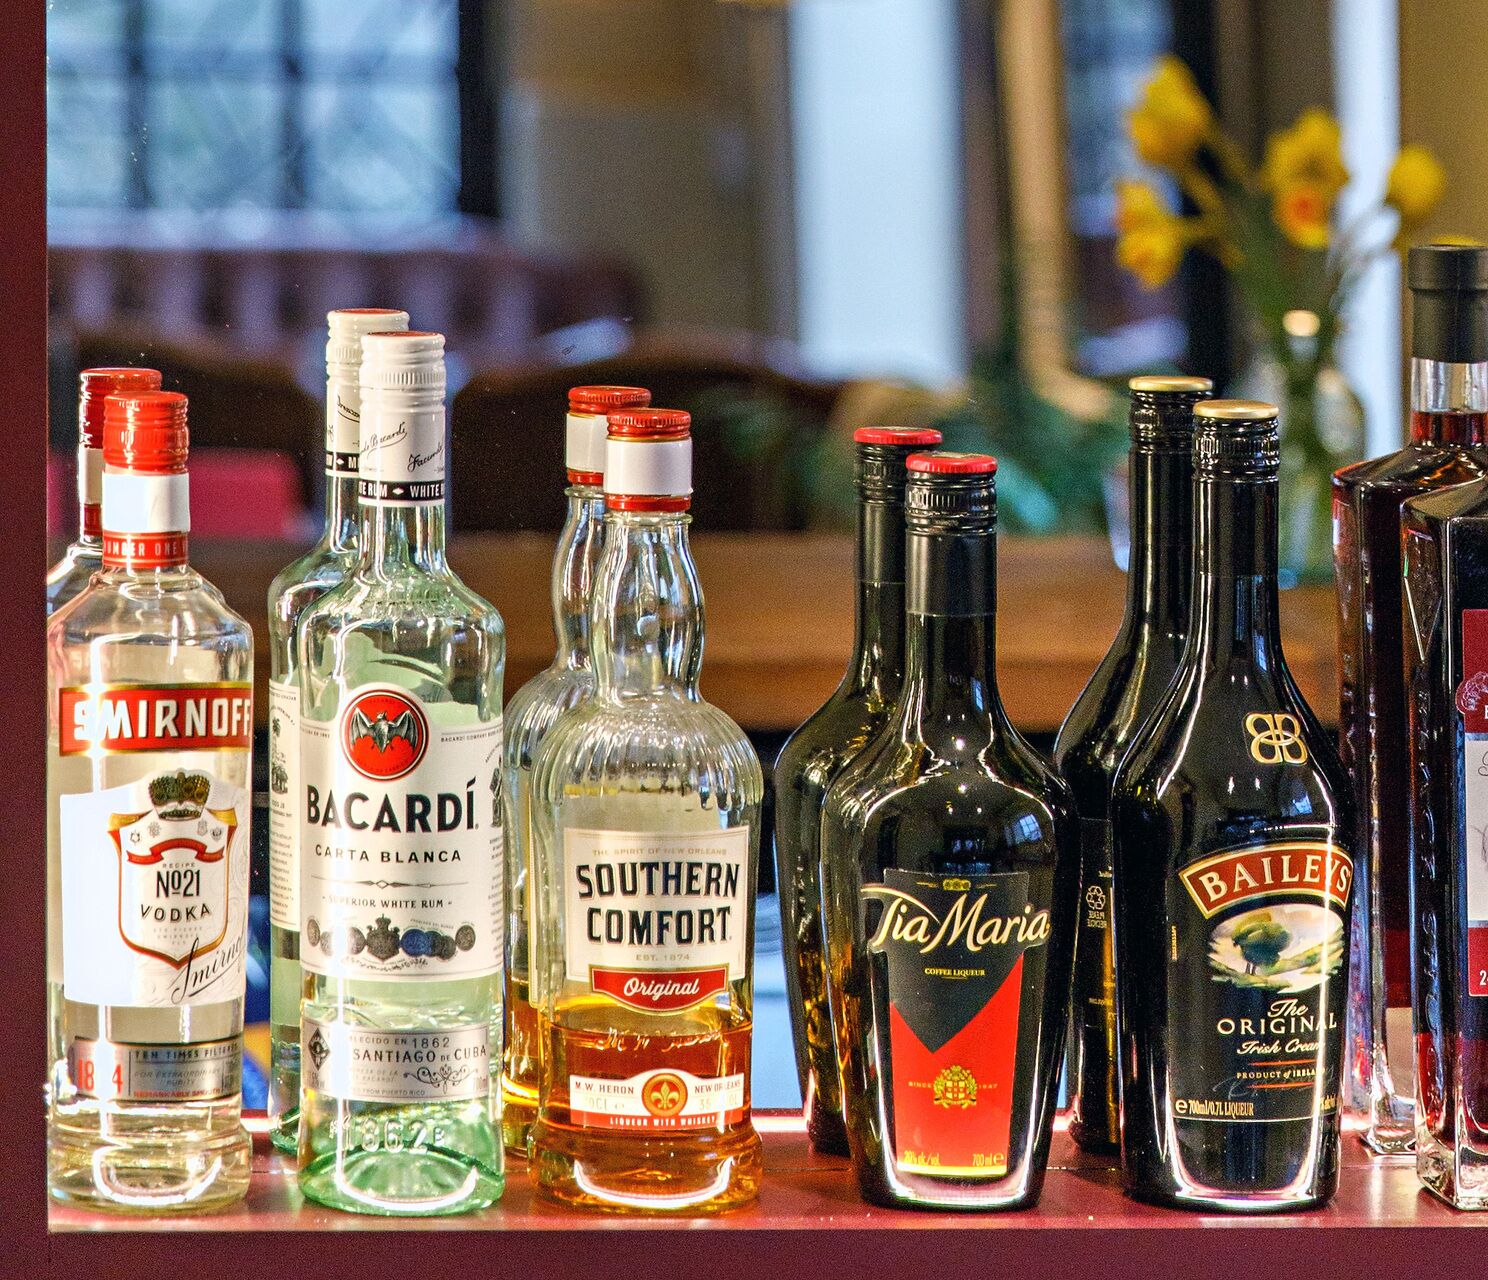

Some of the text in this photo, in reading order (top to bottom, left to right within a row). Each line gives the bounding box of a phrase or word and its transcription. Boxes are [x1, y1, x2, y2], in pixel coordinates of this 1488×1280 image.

[72, 698, 251, 740] SMIRNOFF
[306, 776, 476, 834] BACARDÍ
[315, 844, 462, 864] CARTA BLANCA
[576, 862, 741, 900] SOUTHERN
[1198, 853, 1349, 904] BAILEYS
[140, 903, 212, 923] VODKA
[861, 884, 1051, 954] Tia Maria
[586, 906, 731, 946] COMFORT
[924, 968, 986, 977] COFFEE LIQUEUR
[623, 978, 700, 1002] Original
[1216, 1014, 1338, 1036] ORIGINAL
[412, 1035, 450, 1050] 1862
[610, 1116, 716, 1127] LIQUEUR WITH WHISKEY
